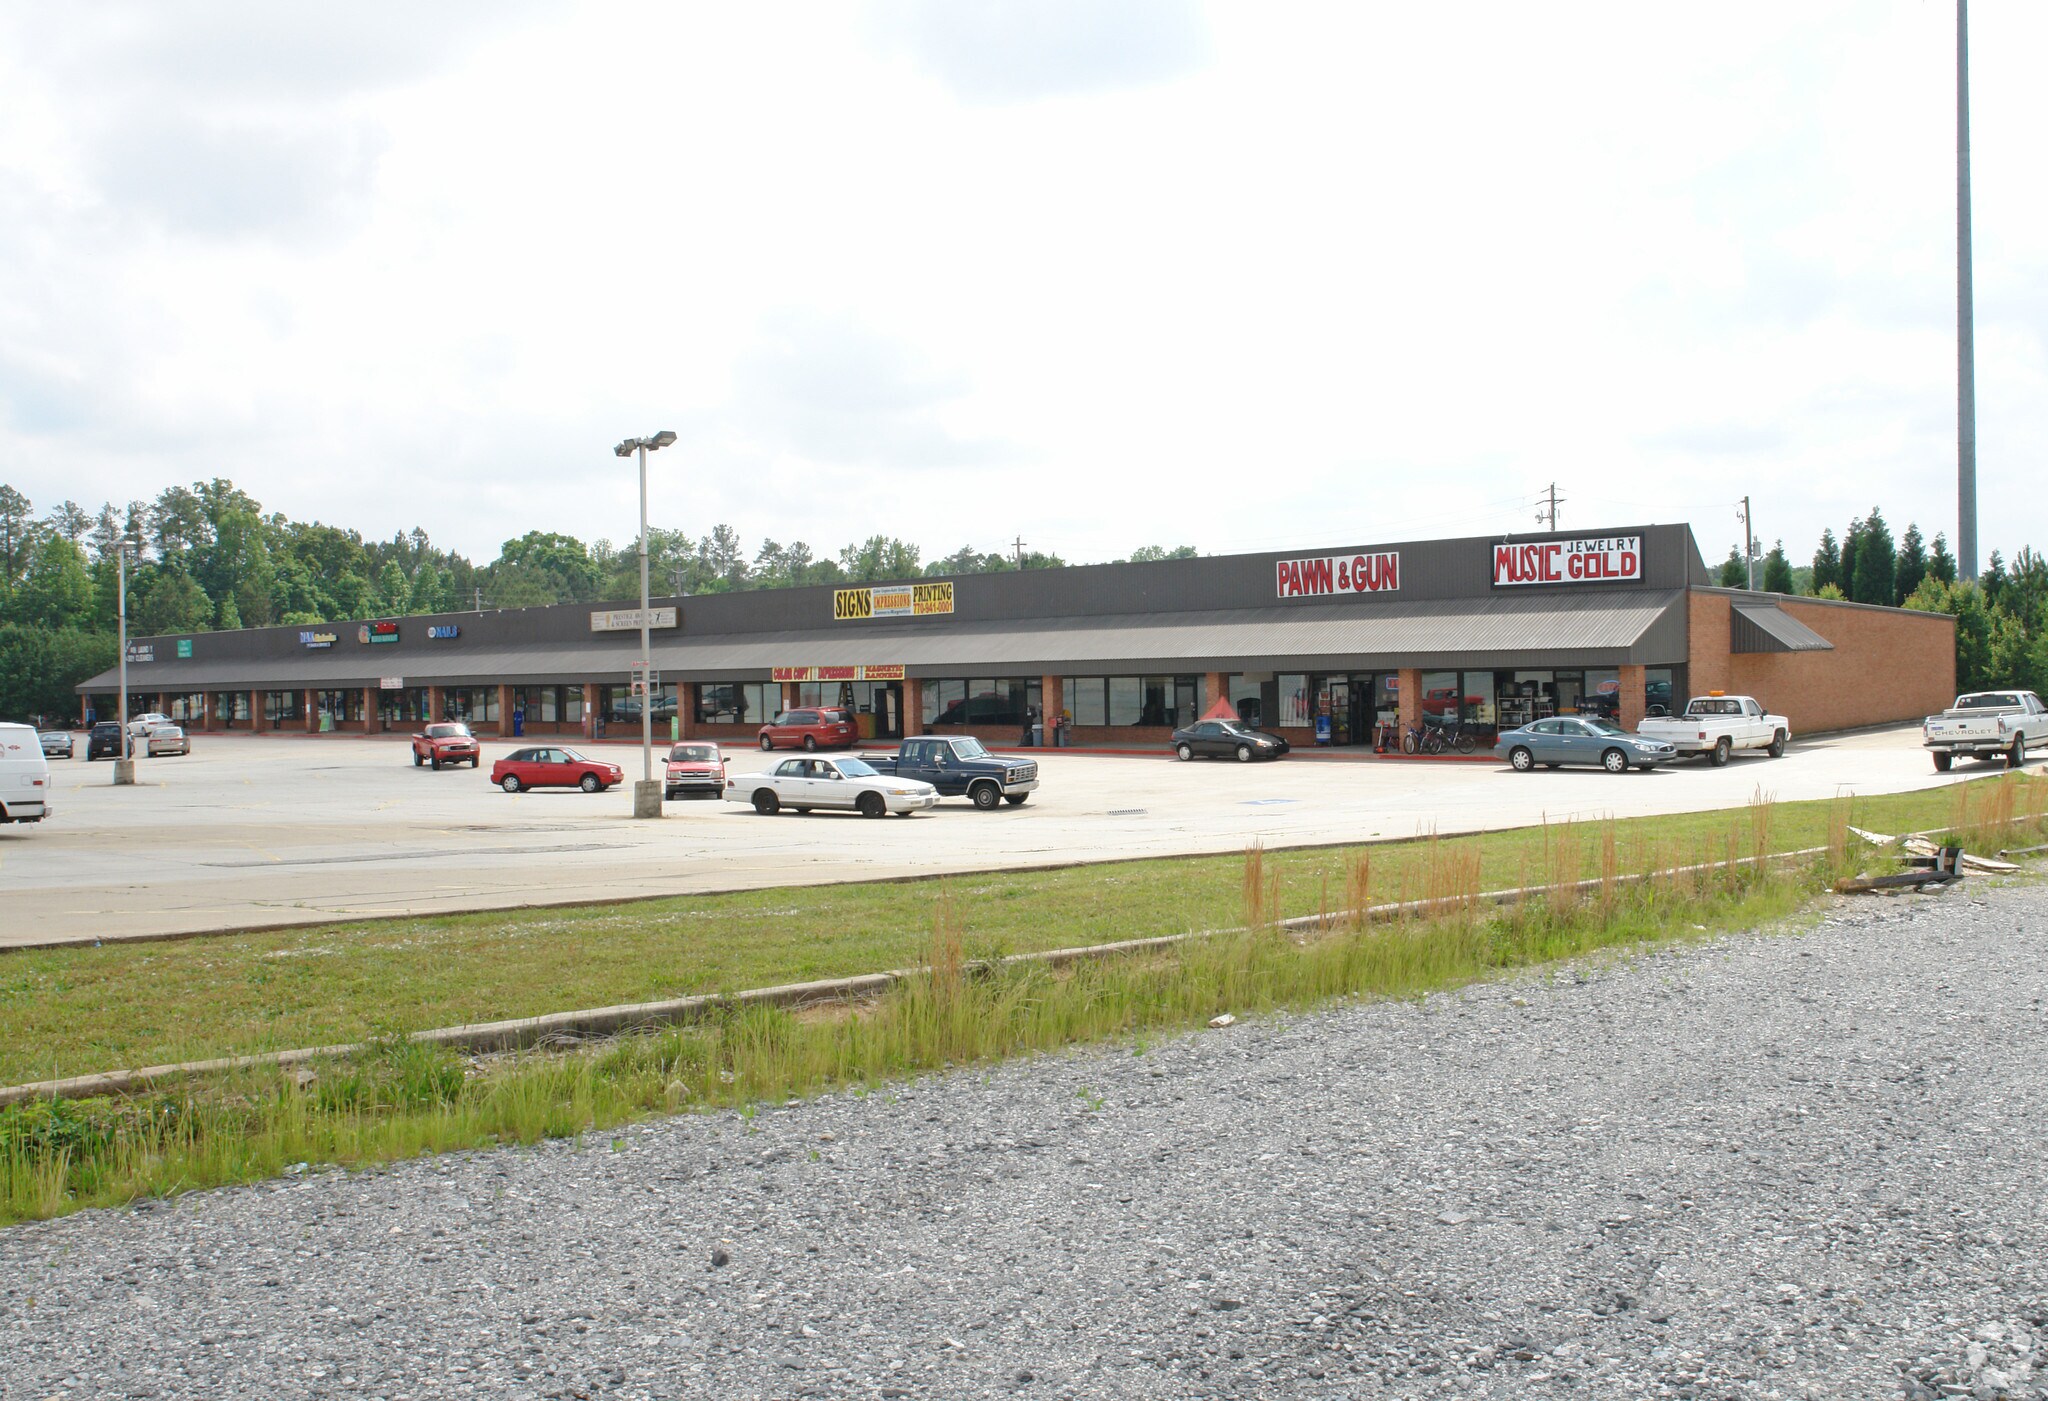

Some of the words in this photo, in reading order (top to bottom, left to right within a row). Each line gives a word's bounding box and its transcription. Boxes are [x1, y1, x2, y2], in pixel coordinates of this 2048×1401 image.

[1567, 538, 1635, 553] JEWELRY
[1494, 545, 1562, 583] MUSIC
[1568, 552, 1637, 579] GOLD
[1278, 558, 1334, 597] PAWN
[1338, 561, 1351, 590] &
[1351, 553, 1398, 592] GUN
[873, 593, 911, 609] IMPRESSIONS
[913, 584, 953, 602] PRINTING
[835, 589, 872, 618] SIGNS
[912, 601, 953, 614] 770-941-0001
[435, 625, 458, 638] NAILS
[773, 667, 793, 681] COLOR
[793, 666, 810, 680] COPY
[1935, 728, 1992, 736] CHEVROLET
